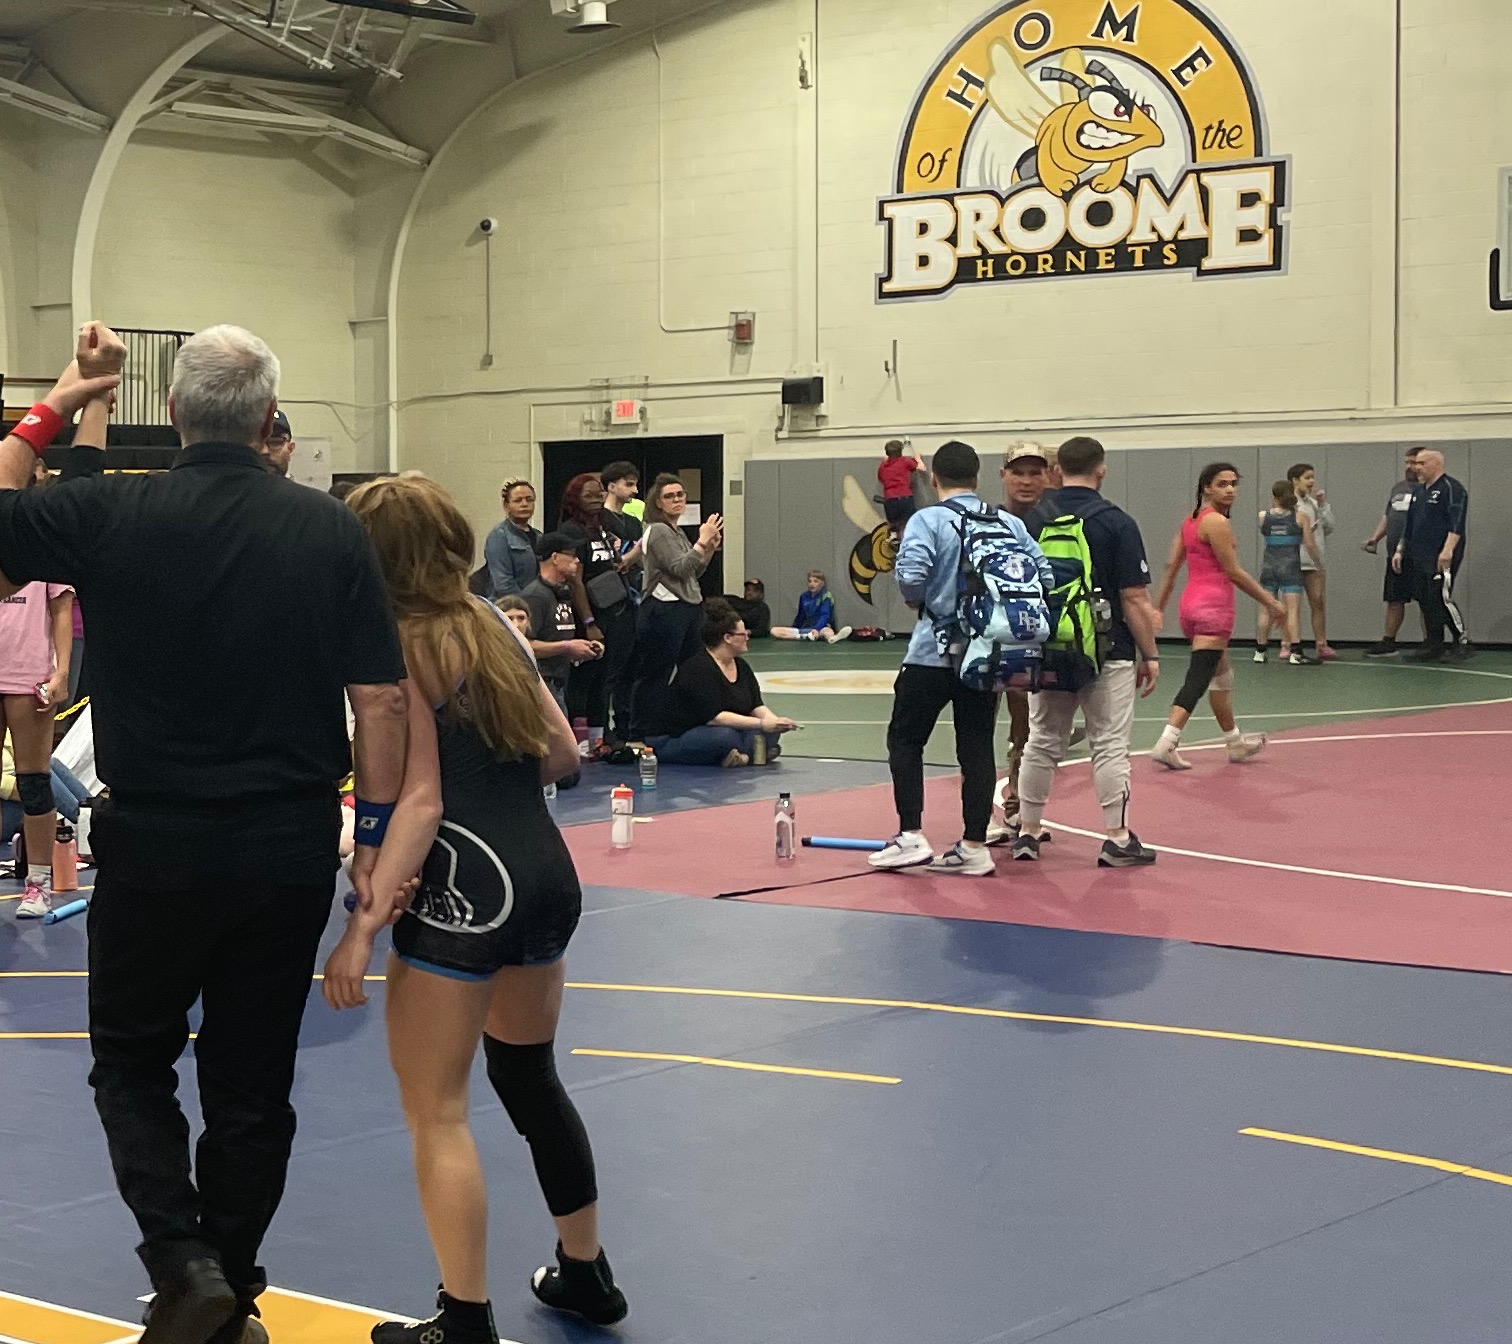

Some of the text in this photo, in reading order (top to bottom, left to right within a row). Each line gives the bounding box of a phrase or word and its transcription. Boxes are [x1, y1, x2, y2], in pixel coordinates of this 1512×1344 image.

[945, 0, 1213, 115] HOME
[1201, 119, 1244, 151] the
[882, 166, 1276, 293] BROOME
[975, 243, 1178, 279] HORNETS
